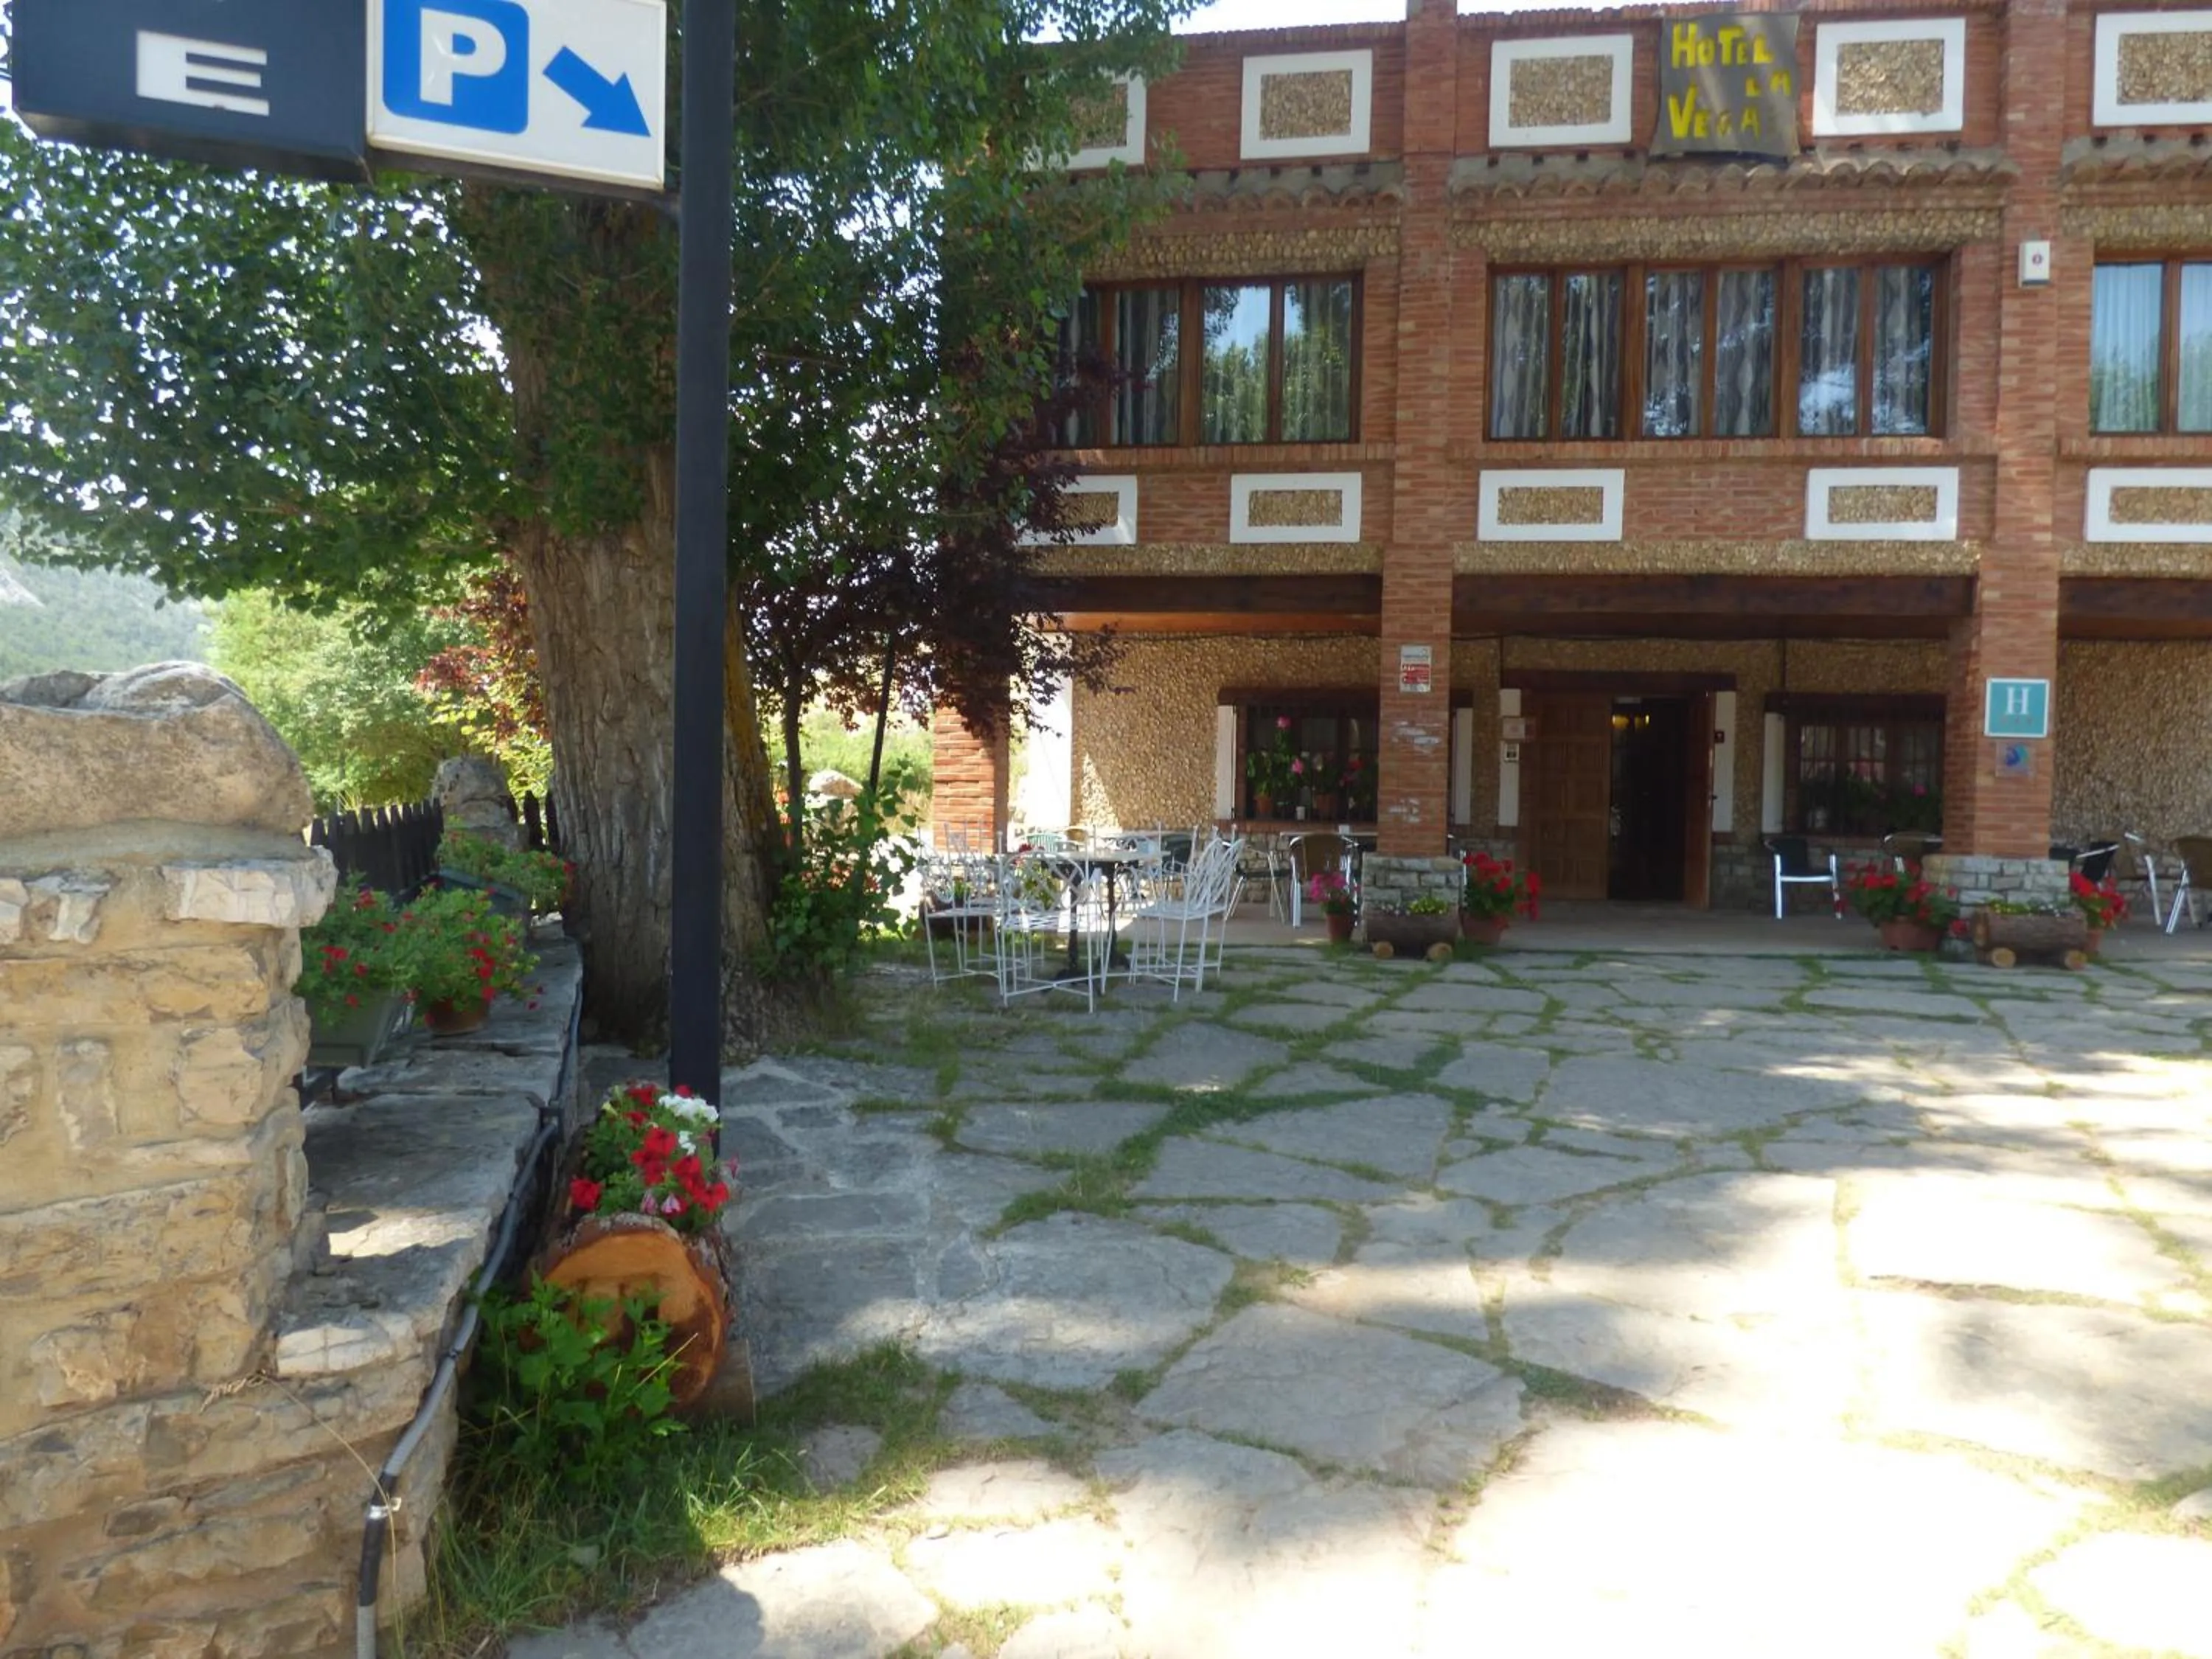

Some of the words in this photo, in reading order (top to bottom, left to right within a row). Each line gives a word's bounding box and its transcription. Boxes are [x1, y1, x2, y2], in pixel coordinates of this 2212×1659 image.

[136, 30, 270, 116] E
[420, 8, 507, 106] P
[2006, 686, 2031, 714] H
